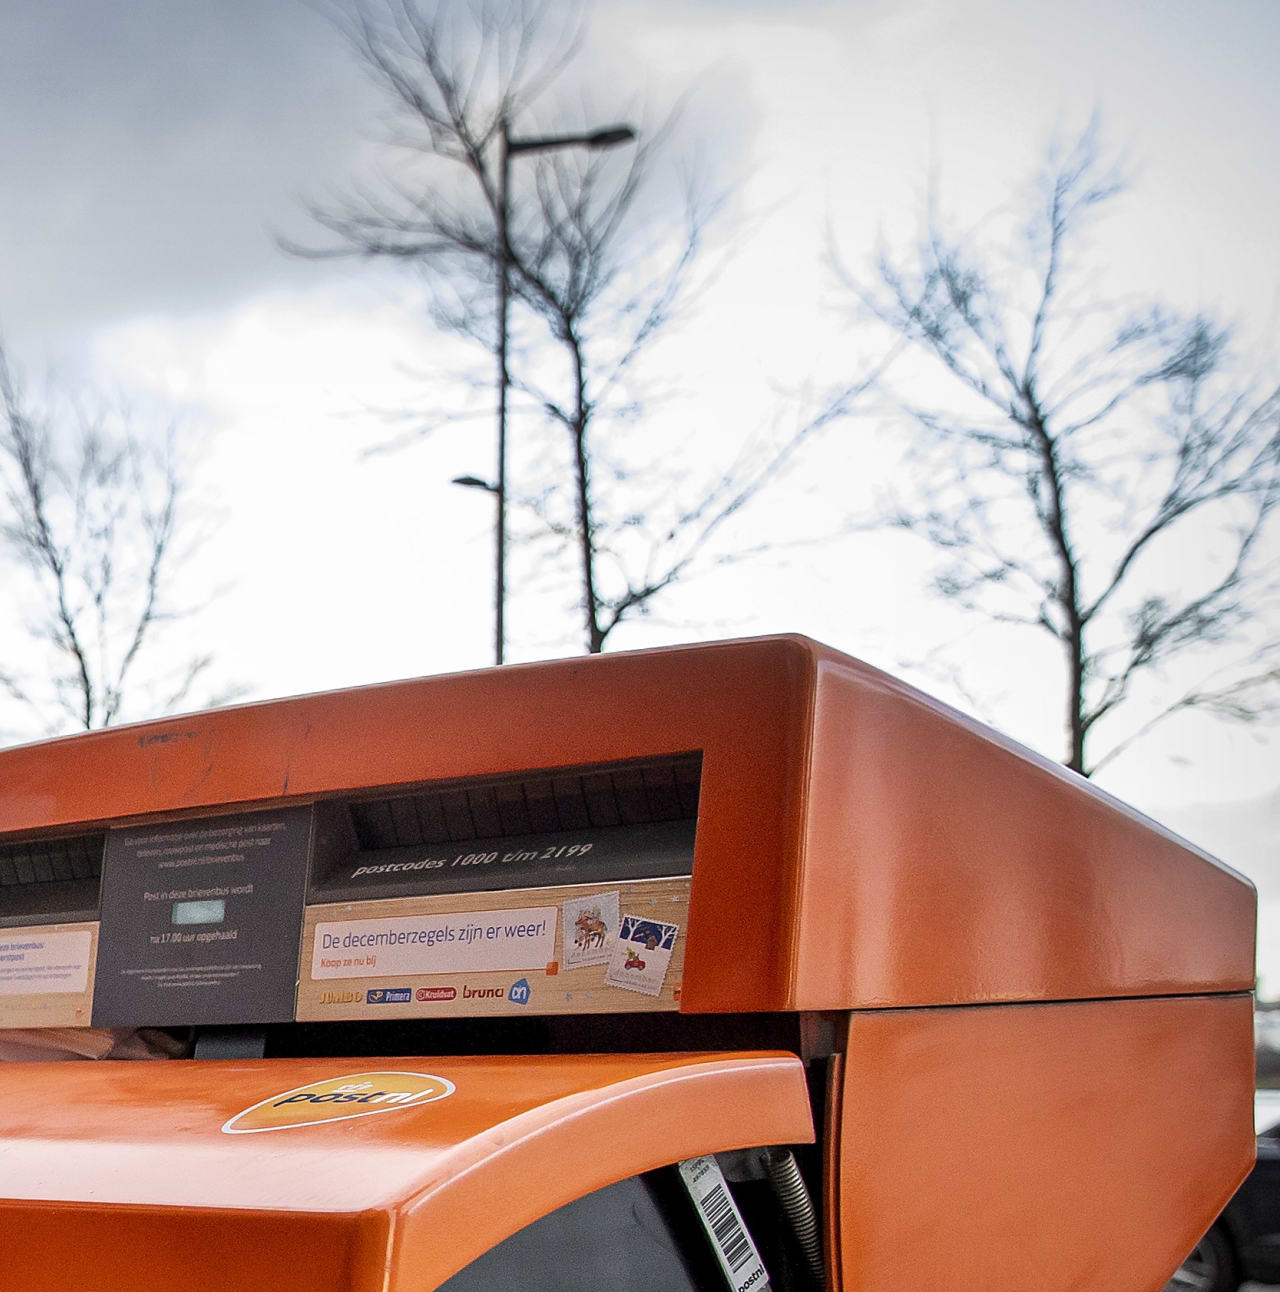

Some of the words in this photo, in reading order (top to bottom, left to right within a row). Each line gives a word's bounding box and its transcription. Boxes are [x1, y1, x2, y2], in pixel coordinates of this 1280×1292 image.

[351, 857, 447, 879] postcodes
[451, 851, 498, 867] 1000
[501, 849, 538, 863] t/m
[539, 843, 593, 859] 2199
[144, 891, 159, 901] Post
[169, 890, 186, 900] deze
[187, 886, 230, 898] brievenbus
[231, 884, 254, 895] wordt
[182, 933, 194, 942] uur
[196, 930, 238, 944] opgehaald
[322, 933, 340, 949] De
[343, 926, 455, 947] decemberzegels
[458, 924, 482, 945] zijn
[486, 924, 501, 940] er
[504, 920, 546, 938] weer!
[320, 957, 341, 968] Koop
[342, 957, 352, 966] ze
[354, 956, 365, 966] nu
[366, 955, 376, 968] bij
[386, 990, 411, 1003] Primera
[424, 990, 456, 1001] Kruidvat
[462, 985, 504, 999] bruna
[273, 1088, 434, 1108] postnl
